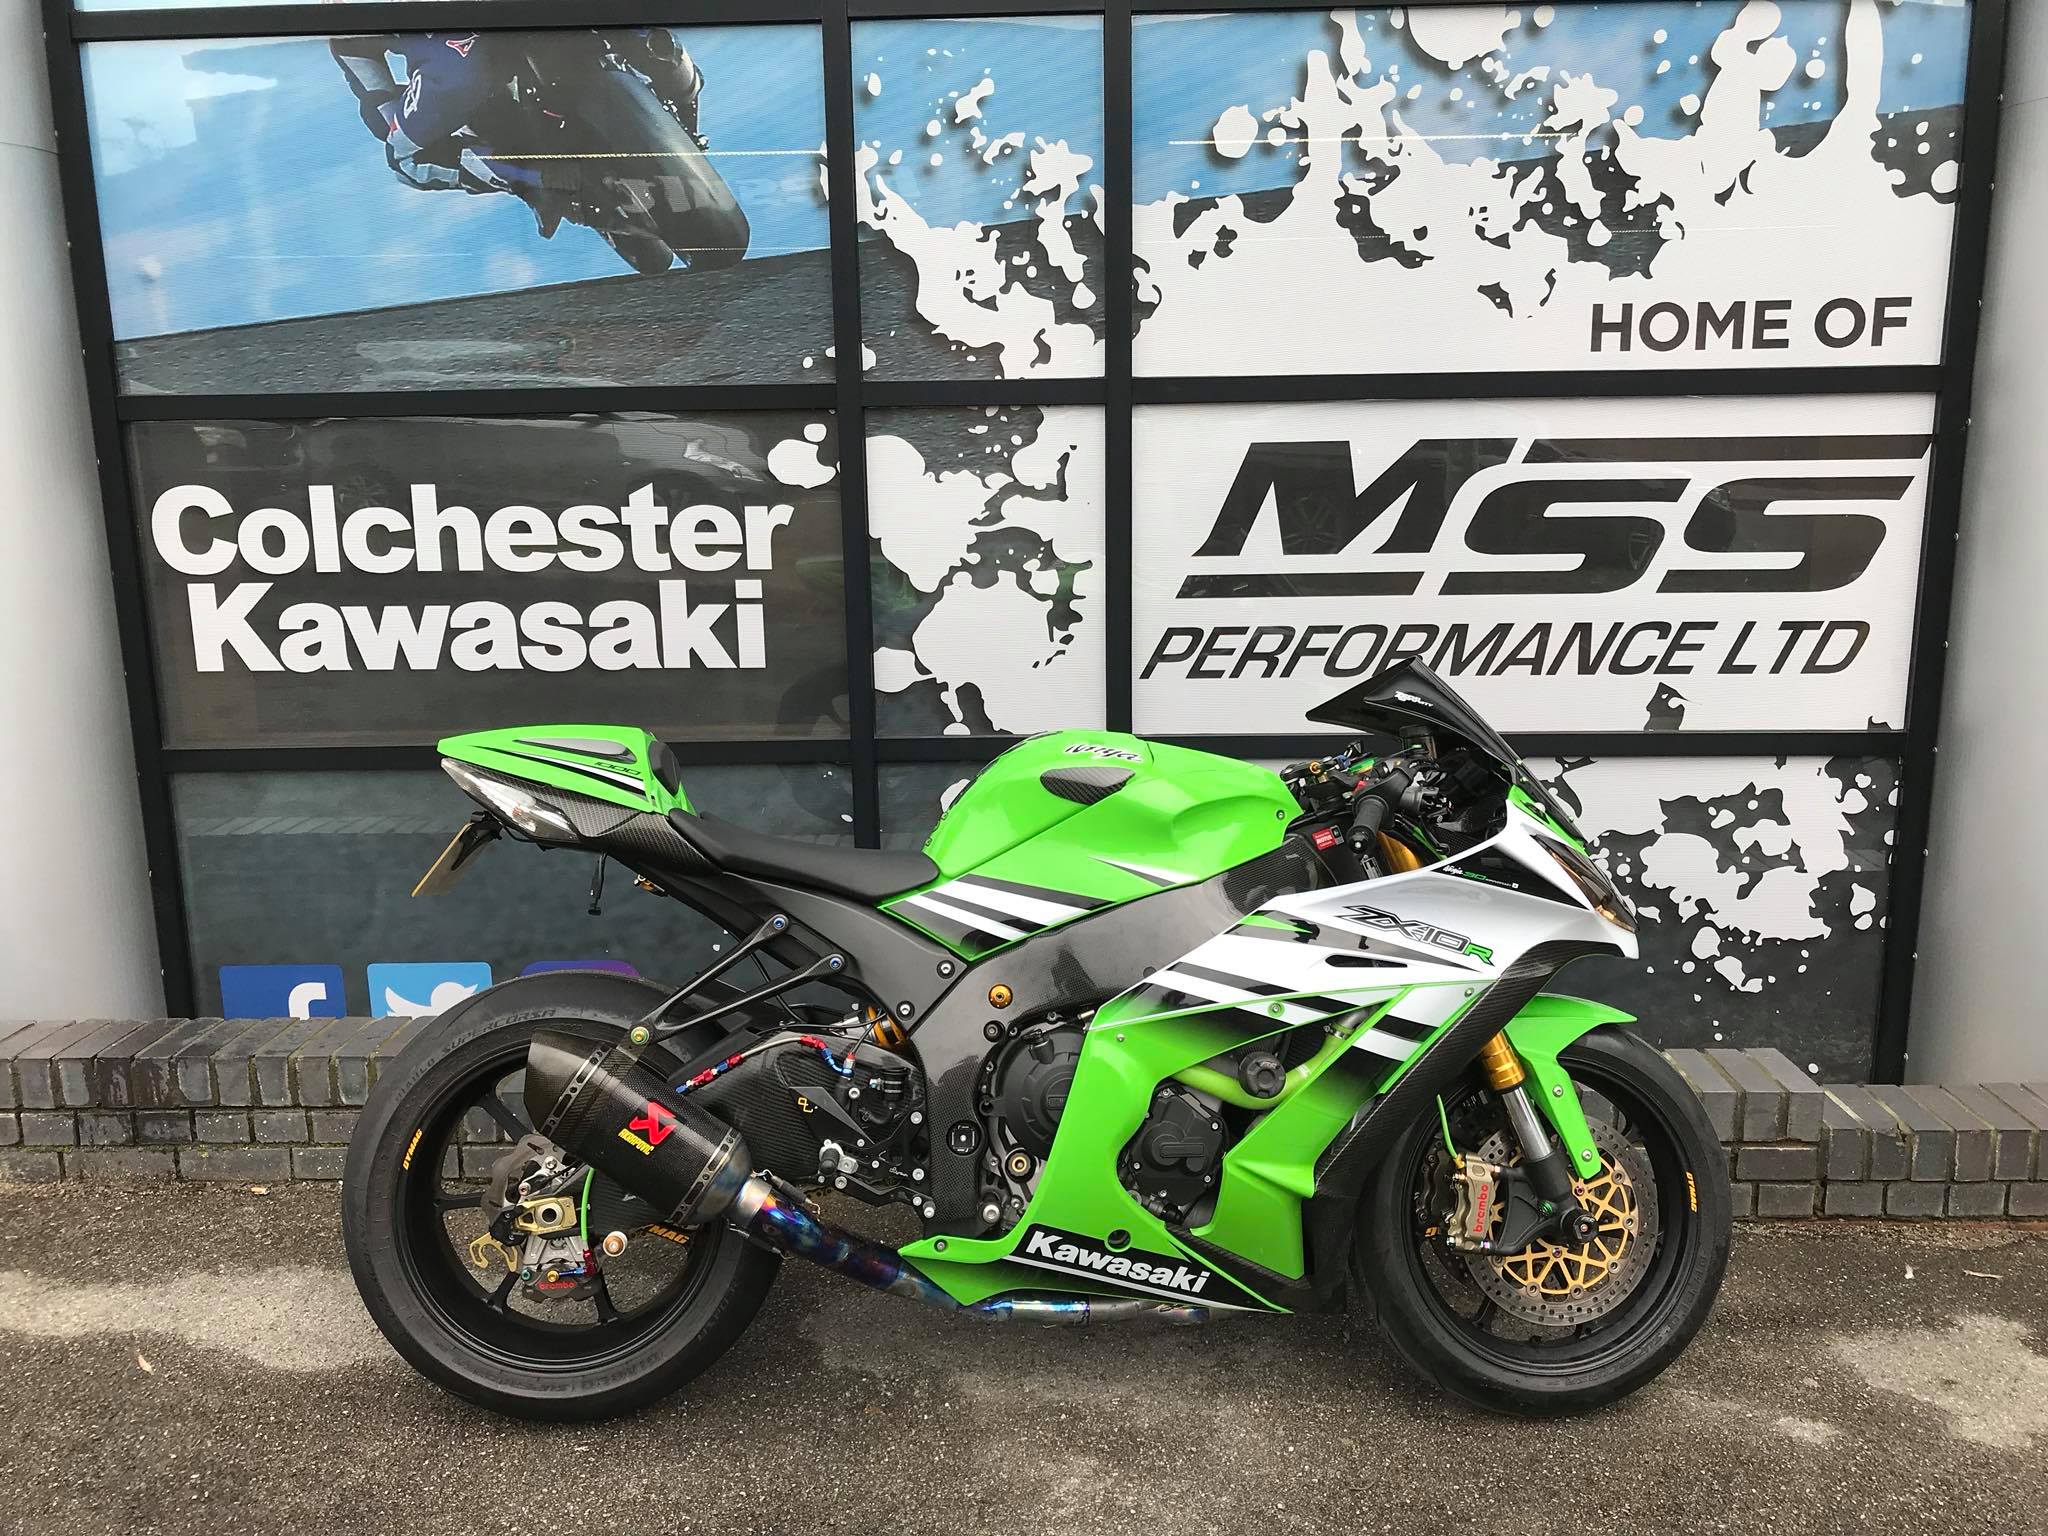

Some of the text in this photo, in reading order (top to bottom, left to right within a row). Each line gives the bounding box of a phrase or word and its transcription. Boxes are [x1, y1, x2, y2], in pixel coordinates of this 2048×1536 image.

[1591, 297, 1912, 352] HOME OF
[151, 482, 794, 576] Colchester
[1175, 434, 1933, 598] MSS
[186, 579, 767, 673] Kawasaki
[1139, 619, 1871, 680] PERFORMANCE LTD
[594, 761, 641, 776] 1000
[1063, 743, 1142, 763] Ninja
[402, 1128, 423, 1171] DYMAG
[1472, 1184, 1488, 1233] brembo
[1685, 1170, 1698, 1213] DYMAG
[648, 1224, 690, 1245] MAG
[537, 1280, 577, 1290] brembo
[1025, 1230, 1211, 1294] Kawasaki
